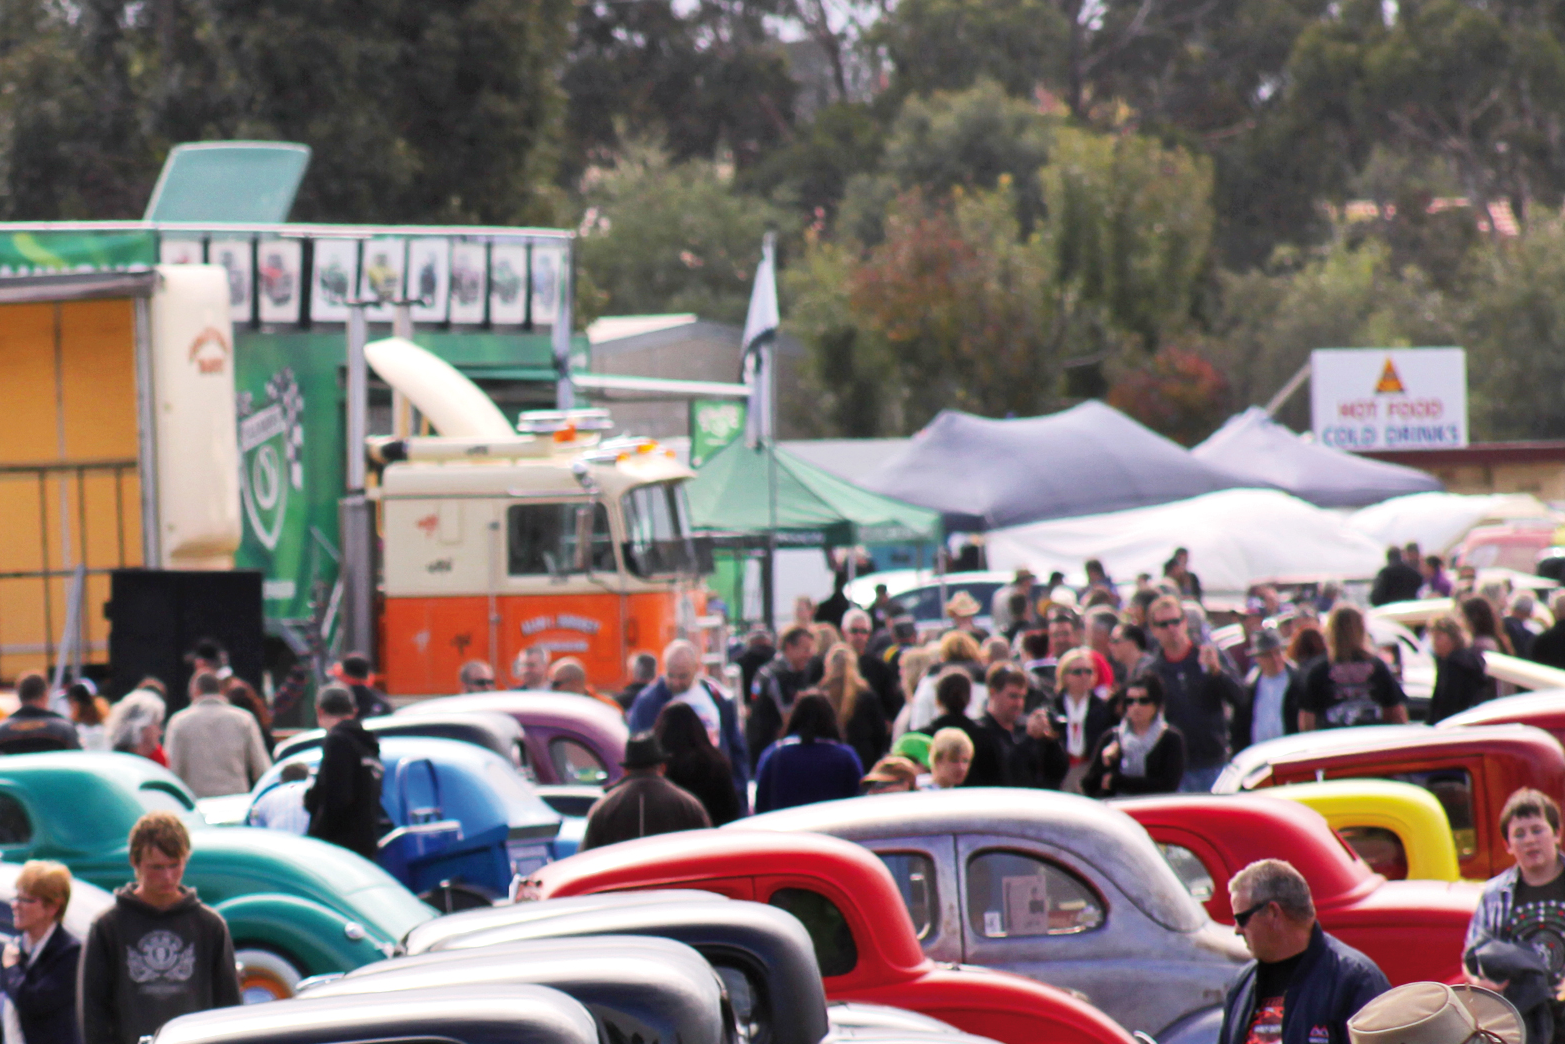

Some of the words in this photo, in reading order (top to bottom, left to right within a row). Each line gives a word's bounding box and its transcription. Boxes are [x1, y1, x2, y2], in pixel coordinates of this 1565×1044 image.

[1338, 402, 1377, 418] HOT
[1387, 401, 1443, 418] FOOD
[1322, 426, 1377, 447] COLD
[1385, 426, 1459, 445] DRINKS
